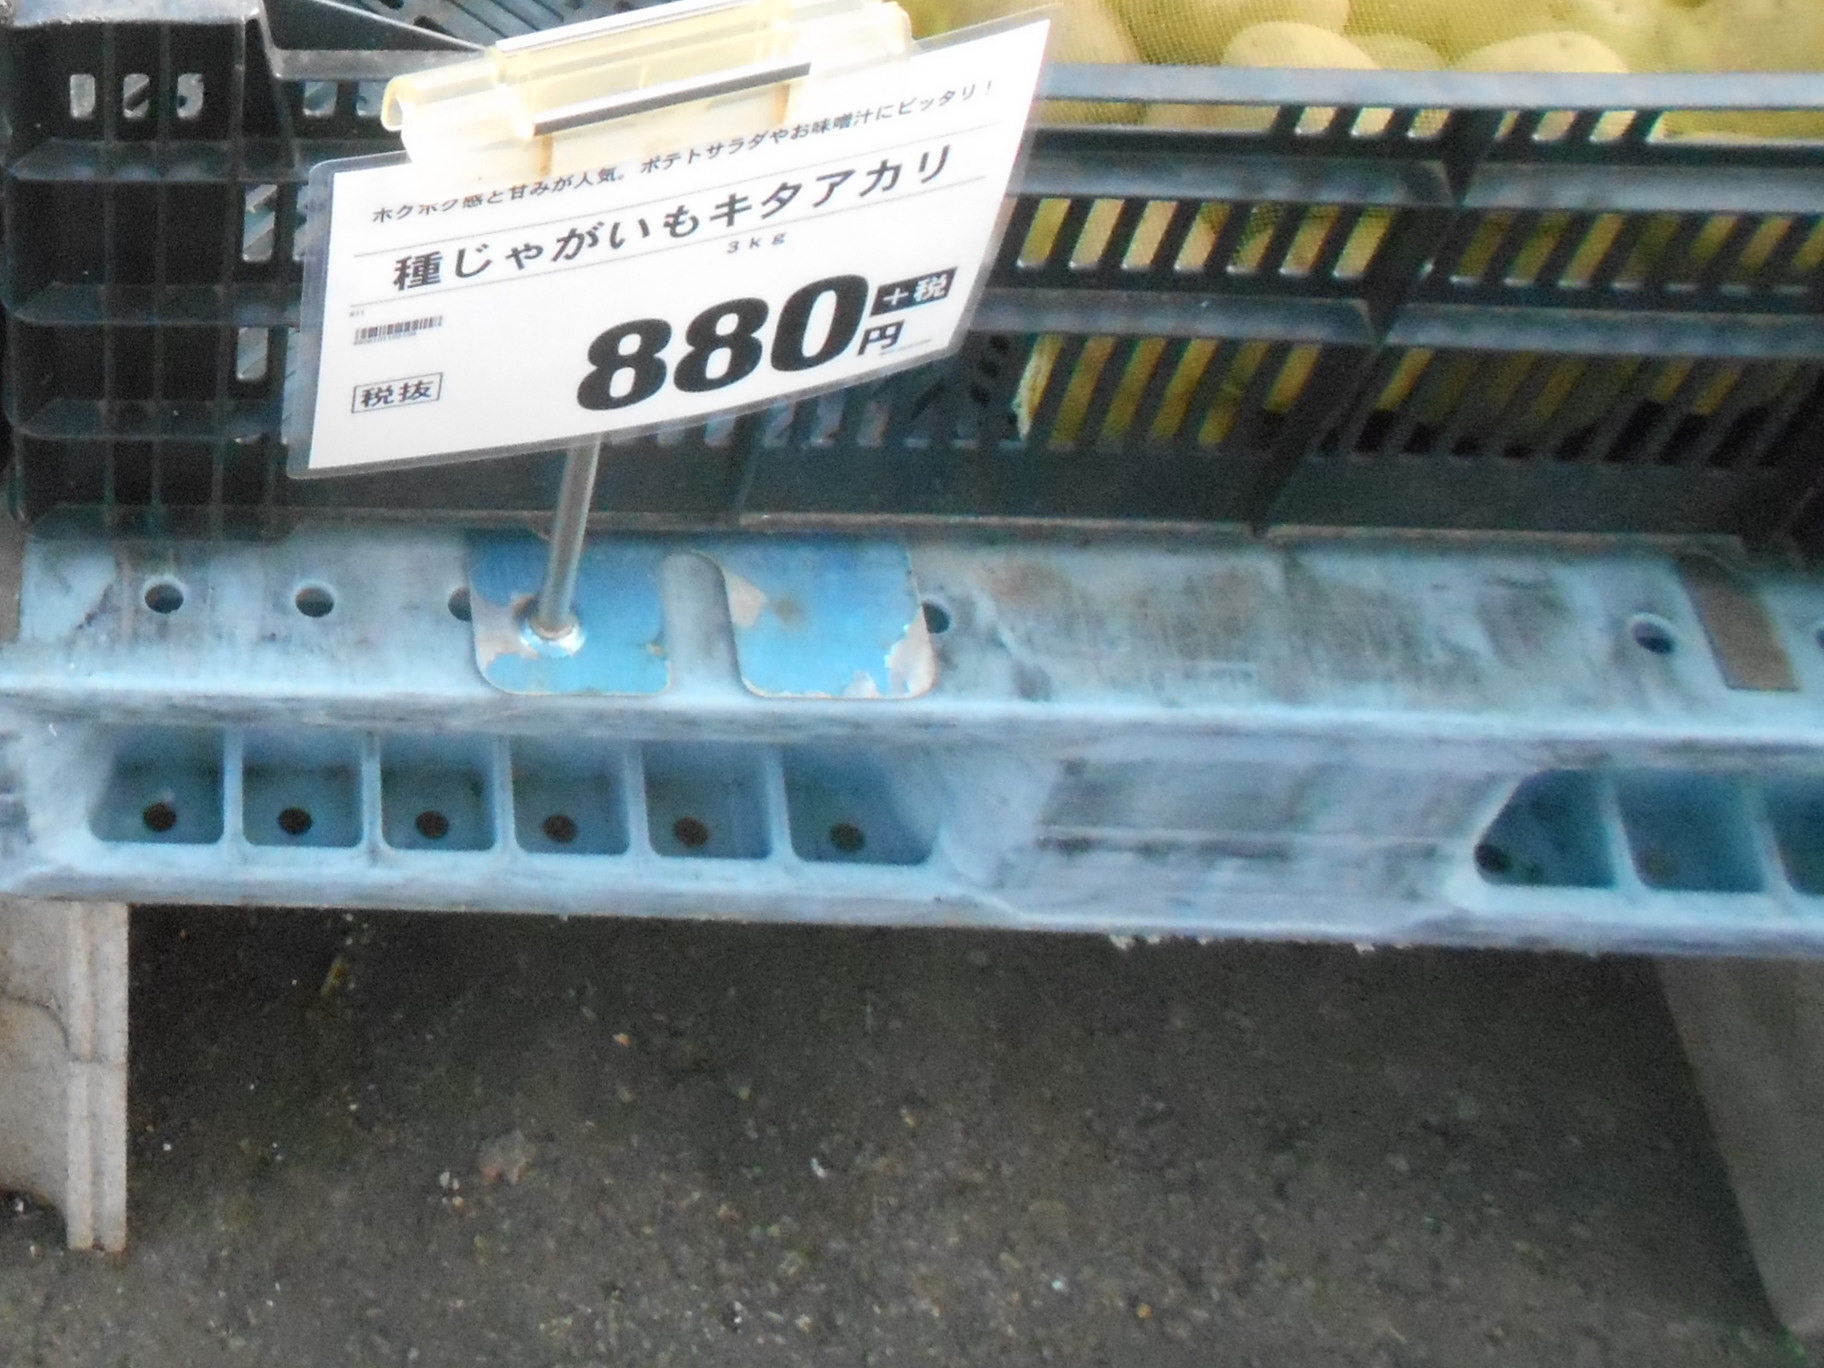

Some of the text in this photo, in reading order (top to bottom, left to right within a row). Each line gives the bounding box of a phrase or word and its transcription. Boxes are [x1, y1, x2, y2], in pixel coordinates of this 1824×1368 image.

[392, 144, 952, 292] 種じゃがいもキタアカリ
[576, 273, 870, 412] 880
[858, 320, 905, 356] 円
[360, 379, 435, 409] 税抜
